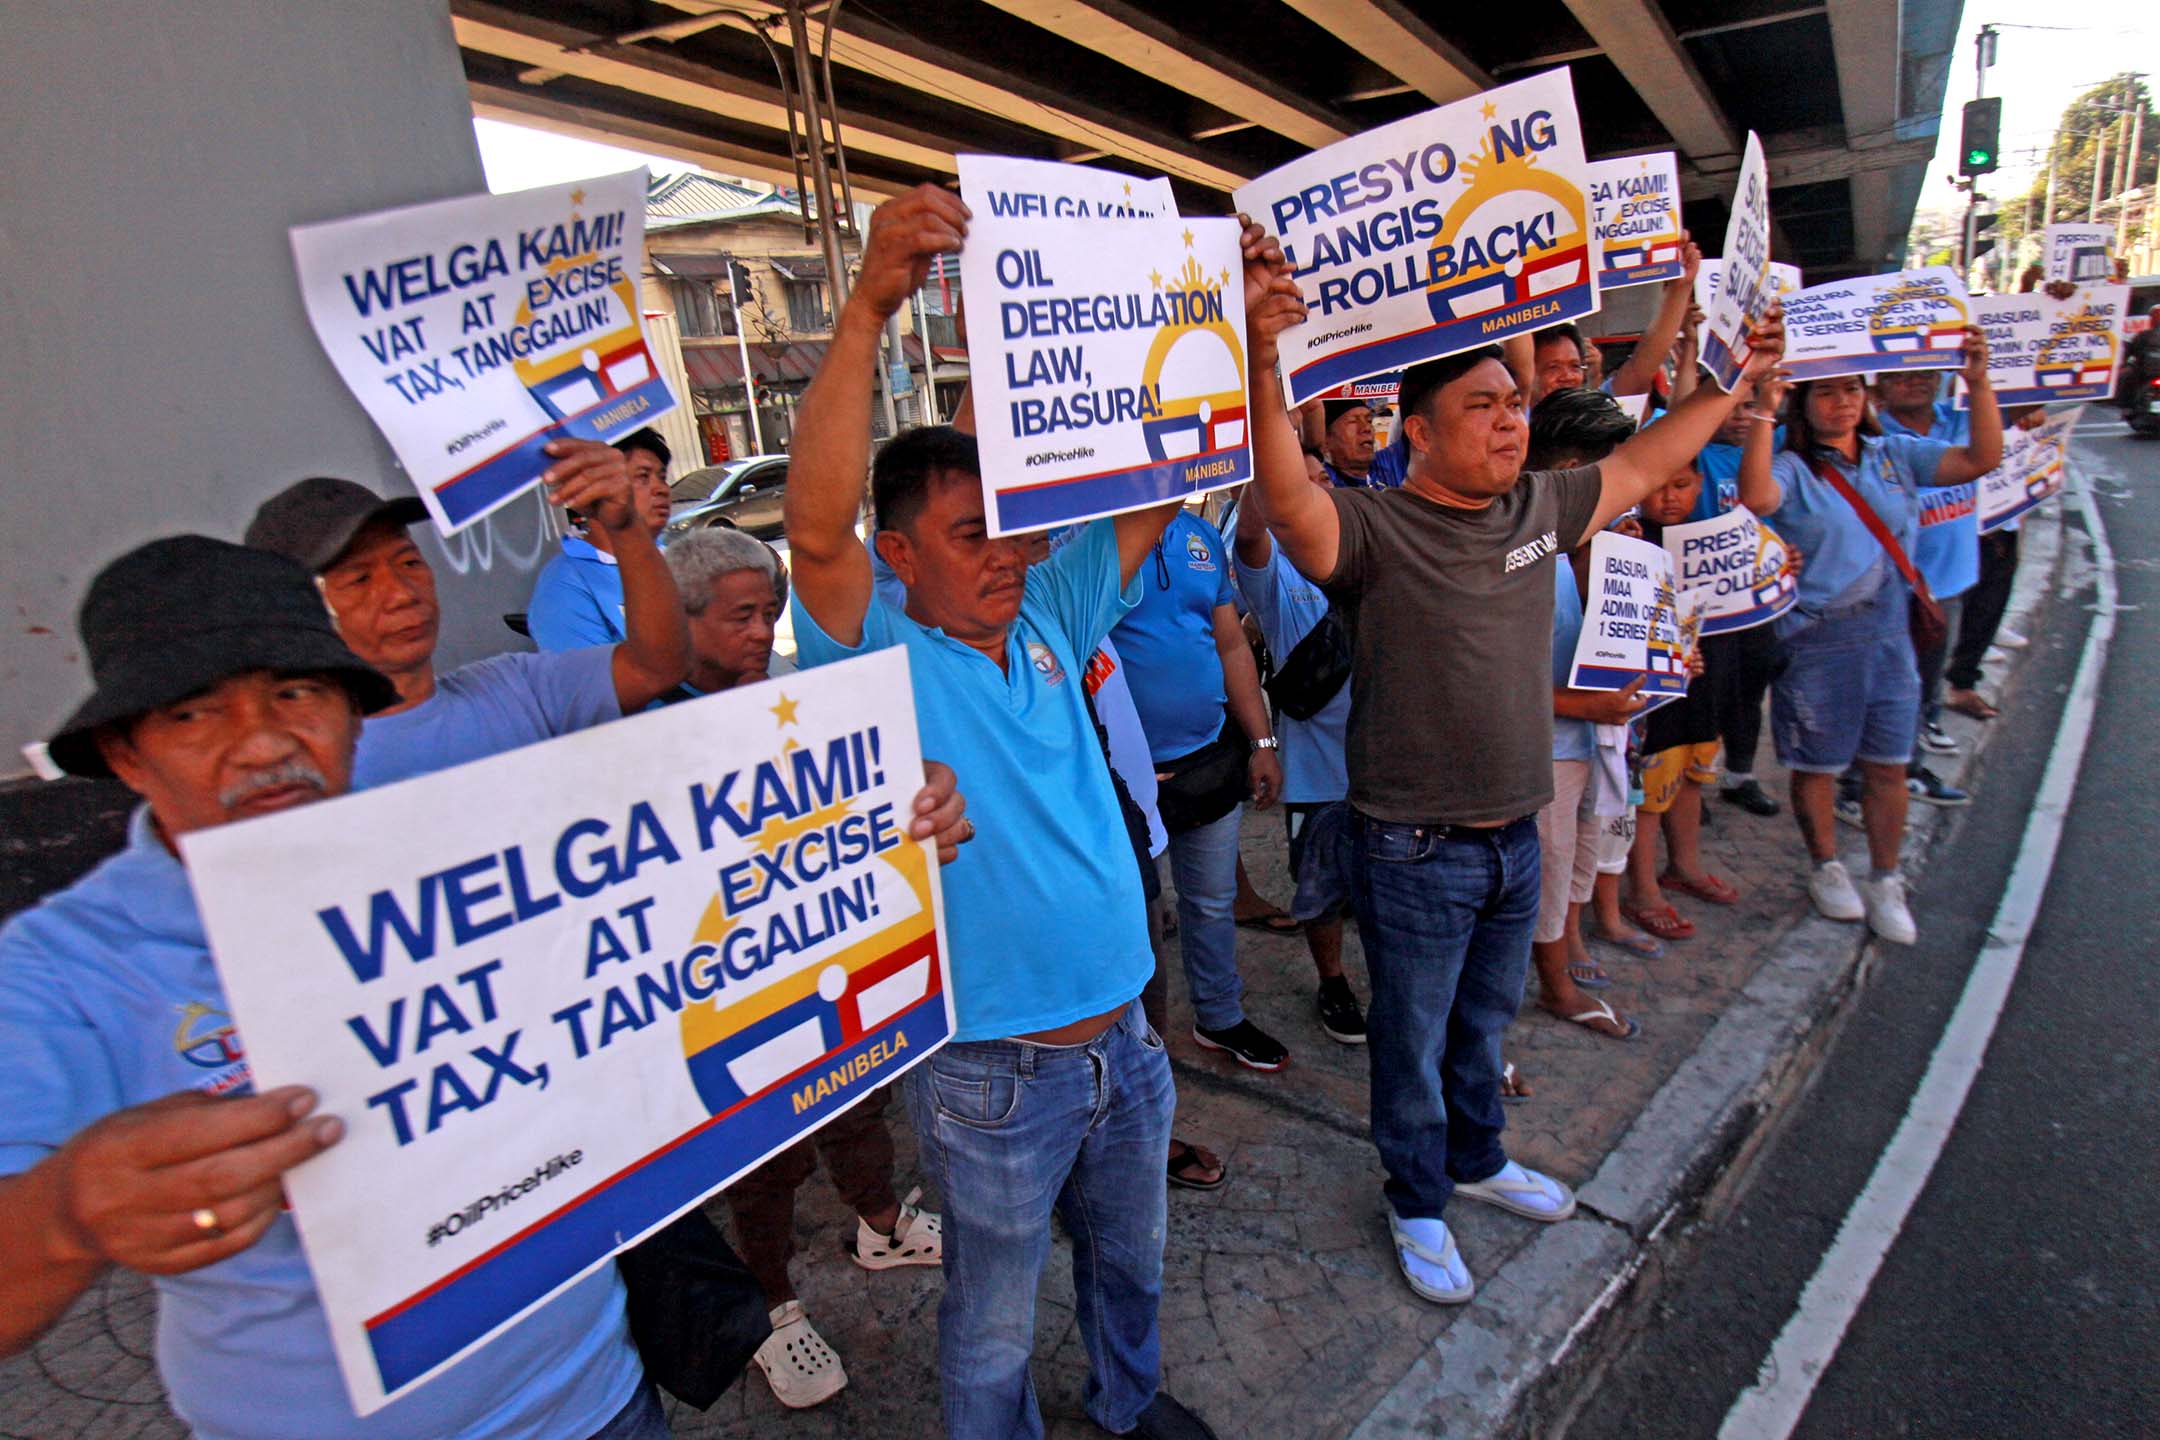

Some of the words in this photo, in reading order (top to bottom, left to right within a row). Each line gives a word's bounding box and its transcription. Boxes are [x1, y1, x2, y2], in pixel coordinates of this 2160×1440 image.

[1272, 143, 1457, 236] PRESYO
[1492, 110, 1558, 164] NG
[1617, 174, 1668, 199] KAMI!
[1621, 197, 1671, 218] EXCISE
[1283, 199, 1443, 280] LANGIS
[1595, 216, 1665, 240] NGGALIN!
[342, 239, 510, 318] WELGA
[518, 211, 625, 271] KAMI!
[995, 249, 1054, 290] OIL
[1872, 286, 1949, 304] REVISED
[1905, 277, 1945, 289] ANG
[361, 316, 427, 366] VAT
[461, 294, 496, 334] AT
[526, 256, 624, 311] EXCISE
[1000, 288, 1225, 340] DEREGULATION
[1482, 300, 1561, 335] MANIBELA
[1786, 311, 1845, 327] ADMIN
[1852, 301, 1916, 319] ORDER
[1803, 320, 1866, 337] SERIES
[1870, 317, 1895, 331] OF
[1897, 314, 1938, 328] 2024
[384, 358, 466, 405] TAX,
[450, 296, 611, 378] TANGGALIN!
[1307, 322, 1373, 349] #OilPriceHike
[1987, 341, 2022, 355] DMIN
[1005, 346, 1093, 390] LAW,
[1010, 383, 1164, 439] IBASURA!
[1025, 446, 1096, 468] #OilPriceHike
[1184, 461, 1236, 484] MANIBELA
[1683, 519, 1756, 558] PRESYO
[1605, 556, 1648, 580] IBASURA
[1683, 544, 1757, 580] LANGIS
[1603, 578, 1632, 598] MIAA
[1601, 599, 1638, 620] ADMIN
[1599, 621, 1605, 637] 1
[1607, 621, 1647, 641] SERIES
[317, 800, 682, 985] WELGA
[689, 725, 887, 853] KAMI!
[346, 959, 503, 1069] VAT
[583, 897, 656, 980] AT
[718, 801, 901, 917] EXCISE
[366, 1028, 551, 1148] TAX,
[552, 871, 881, 1061] TANGGALIN!
[790, 1030, 909, 1116] MANIBELA
[425, 1146, 585, 1249] #OilPriceHike
